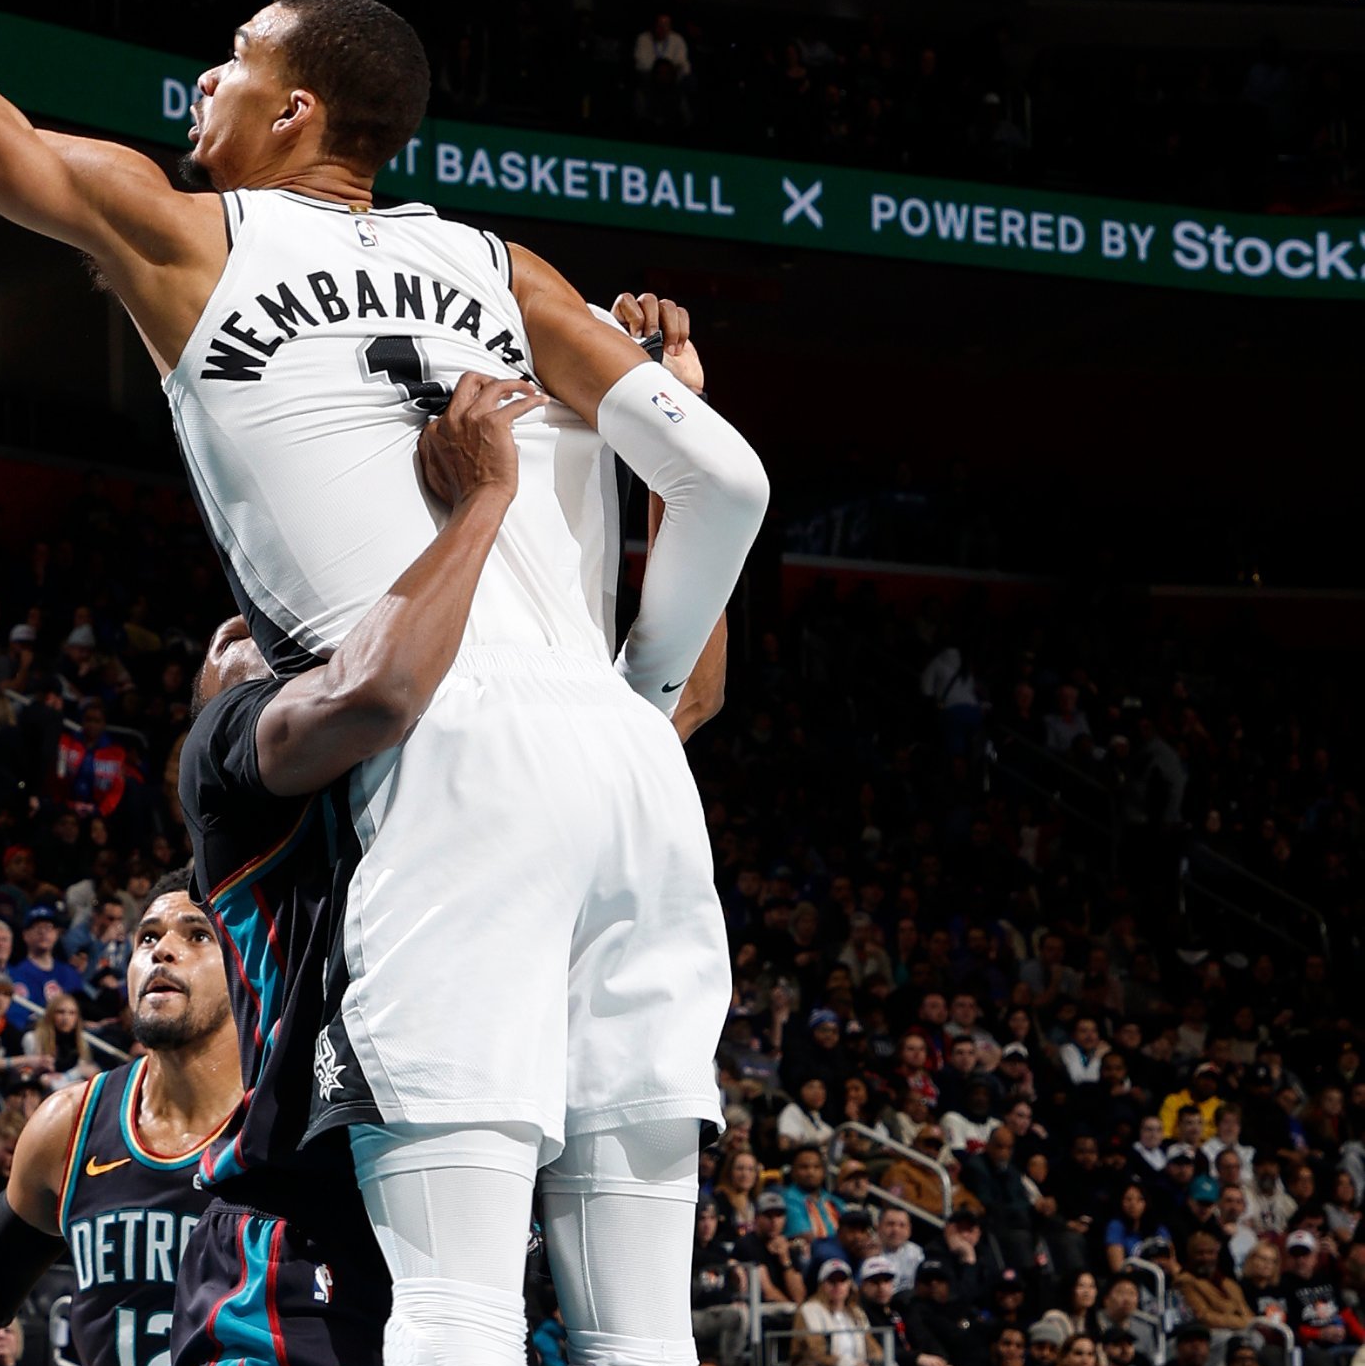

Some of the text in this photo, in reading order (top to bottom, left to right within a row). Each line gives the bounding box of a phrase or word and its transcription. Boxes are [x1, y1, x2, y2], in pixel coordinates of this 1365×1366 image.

[436, 143, 735, 215] BASKETBALL
[871, 193, 1085, 253] POWERED
[1101, 219, 1155, 261] BY
[1172, 220, 1365, 280] Stock
[200, 269, 543, 388] WEMBANYAM
